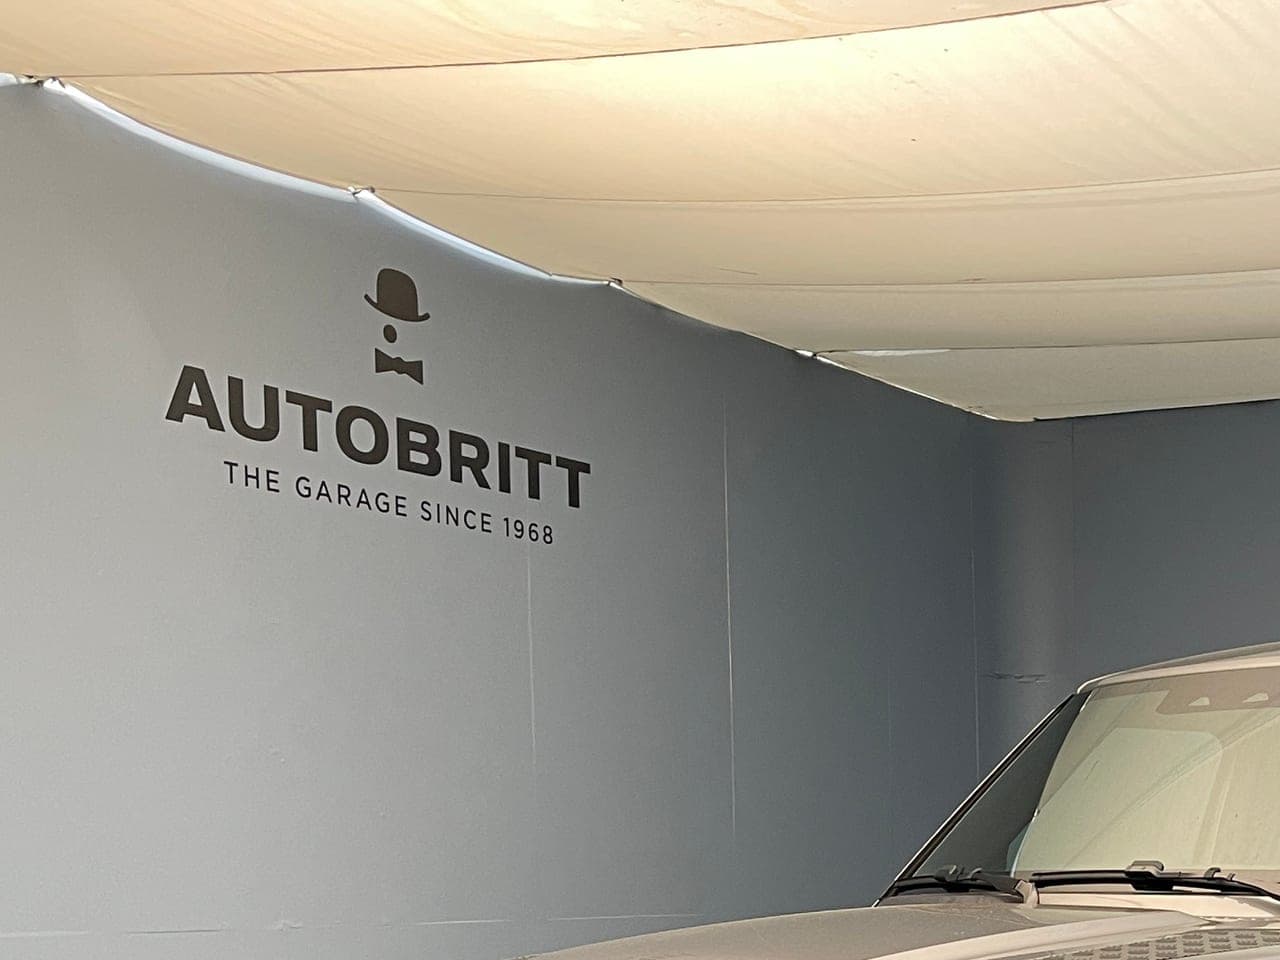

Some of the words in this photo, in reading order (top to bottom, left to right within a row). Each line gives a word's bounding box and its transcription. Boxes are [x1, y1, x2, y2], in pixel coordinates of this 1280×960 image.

[165, 365, 591, 508] AUTOBRITT
[223, 460, 280, 492] THE
[295, 476, 408, 518] GARAGE
[420, 501, 493, 534] SINCE
[503, 517, 554, 545] 1968
